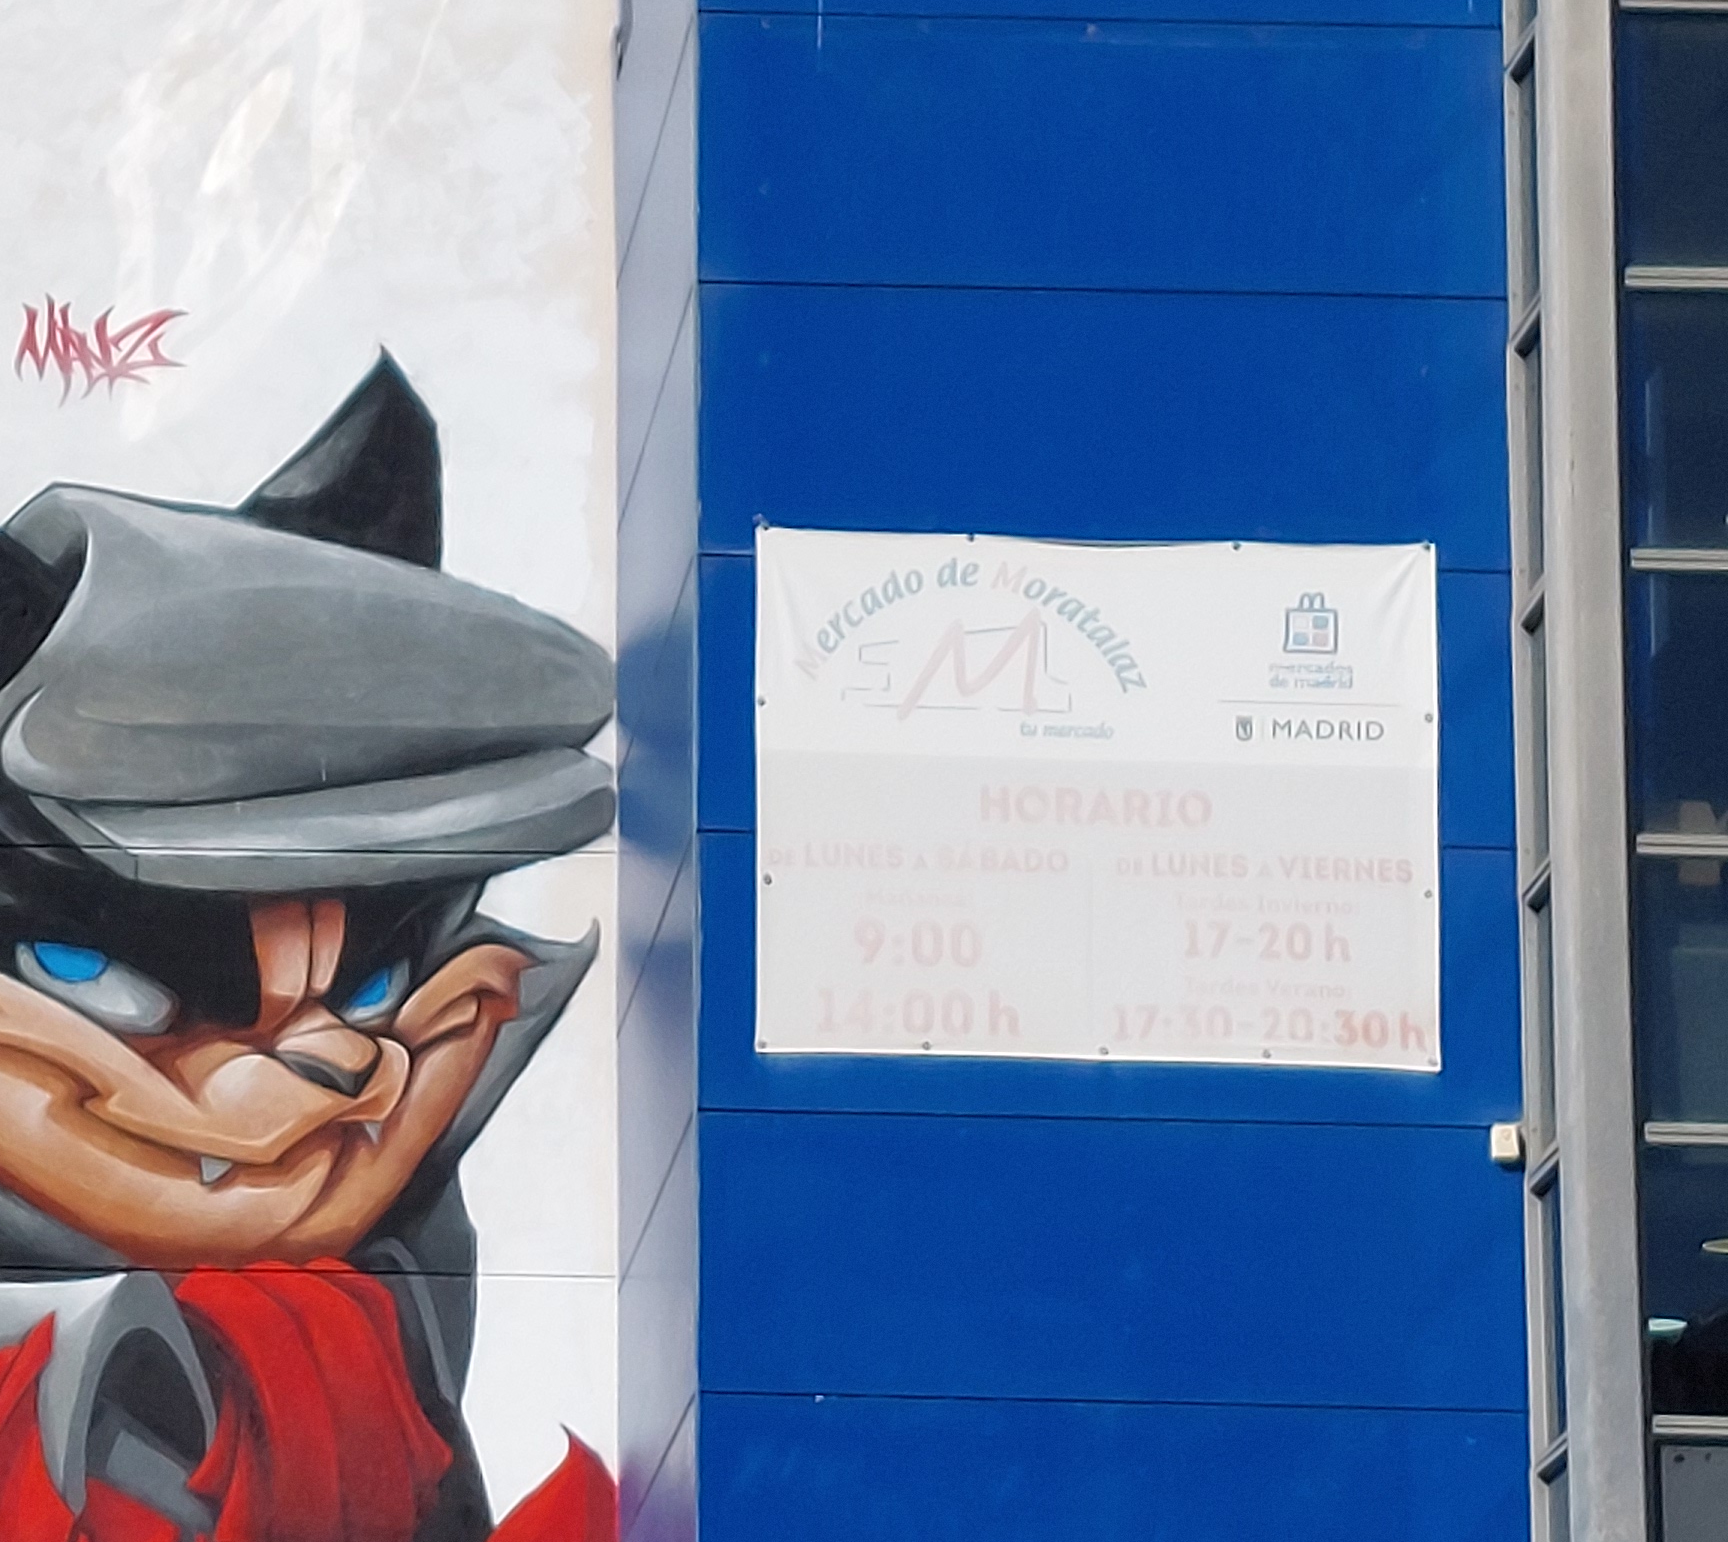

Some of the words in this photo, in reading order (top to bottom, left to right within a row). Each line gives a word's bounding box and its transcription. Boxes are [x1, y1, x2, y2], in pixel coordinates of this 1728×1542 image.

[794, 569, 924, 680] Mercado
[937, 557, 980, 588] de
[991, 561, 1148, 694] Moratalaz
[1268, 675, 1289, 689] de
[1293, 675, 1354, 690] madrid
[1019, 721, 1038, 737] tu
[1042, 721, 1115, 740] mercado
[1271, 717, 1385, 741] MADRID
[979, 784, 1213, 828] HORARIO
[804, 841, 904, 870] LUNES
[1116, 857, 1143, 876] DE
[1151, 852, 1249, 878] LUNES
[1277, 855, 1414, 884] VIERNES
[853, 918, 983, 968] 9:00
[1184, 920, 1313, 961] 17-20
[1324, 921, 1352, 962] h
[816, 987, 976, 1036] 14:00
[988, 989, 1021, 1036] h
[1398, 1010, 1429, 1053] h
